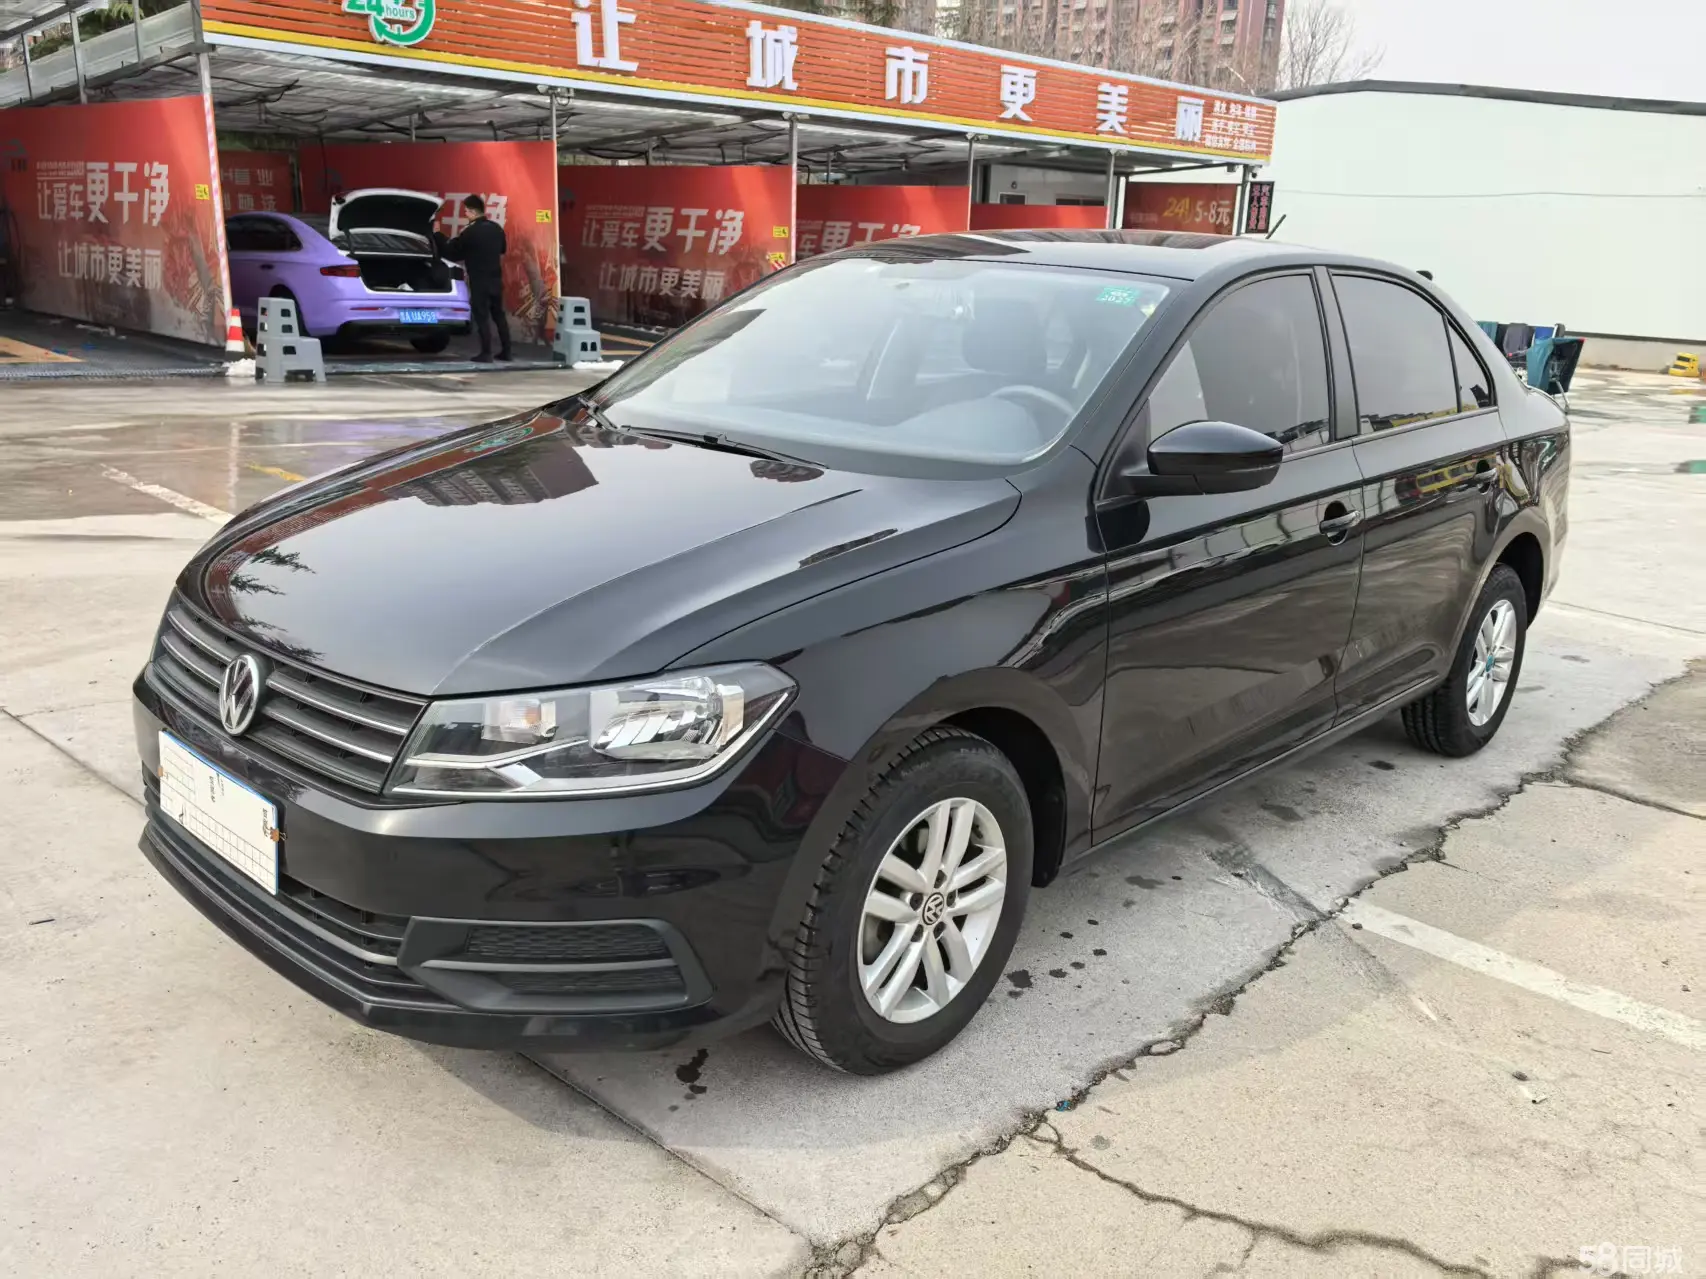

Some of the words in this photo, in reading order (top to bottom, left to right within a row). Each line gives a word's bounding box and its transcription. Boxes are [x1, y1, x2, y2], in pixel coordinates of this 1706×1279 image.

[385, 6, 415, 19] hours
[57, 241, 163, 289] 让城市更美丽
[599, 261, 726, 301] 让城市更美丽
